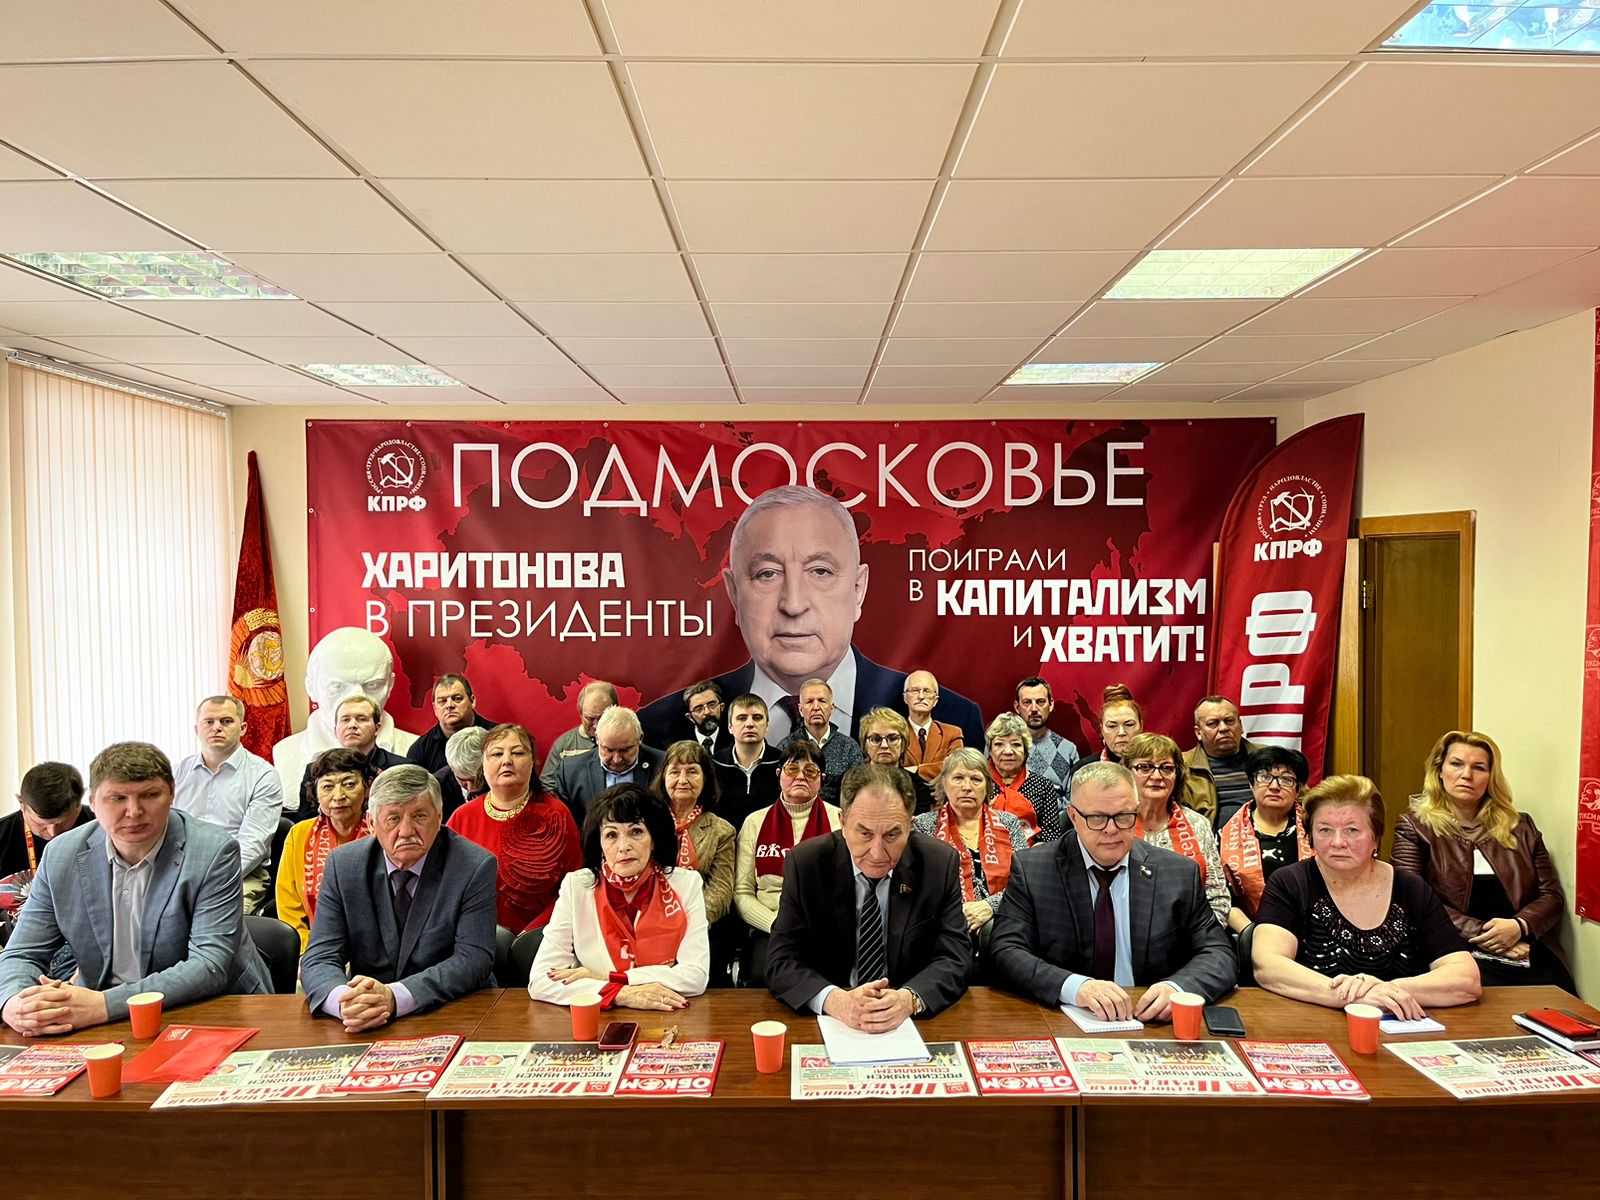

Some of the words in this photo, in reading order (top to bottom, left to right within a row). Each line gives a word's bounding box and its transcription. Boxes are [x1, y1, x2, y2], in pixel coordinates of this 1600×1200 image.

[453, 441, 1145, 517] ПОДМОСКОВЬЕ
[367, 495, 427, 512] КПРФ
[908, 548, 1067, 572] ПОИГРАЛИ
[1253, 538, 1323, 562] КПРФ
[361, 551, 625, 589] ХАРИТОНОВА
[910, 581, 924, 602] В
[936, 577, 1208, 617] КАПИТАЛИЗМ
[365, 600, 390, 638] В
[408, 600, 713, 642] ПРЕЗИДЕНТЫ
[1013, 625, 1033, 648] И
[1039, 625, 1205, 663] ХВАТИТ!
[1239, 590, 1317, 752] ПРФ
